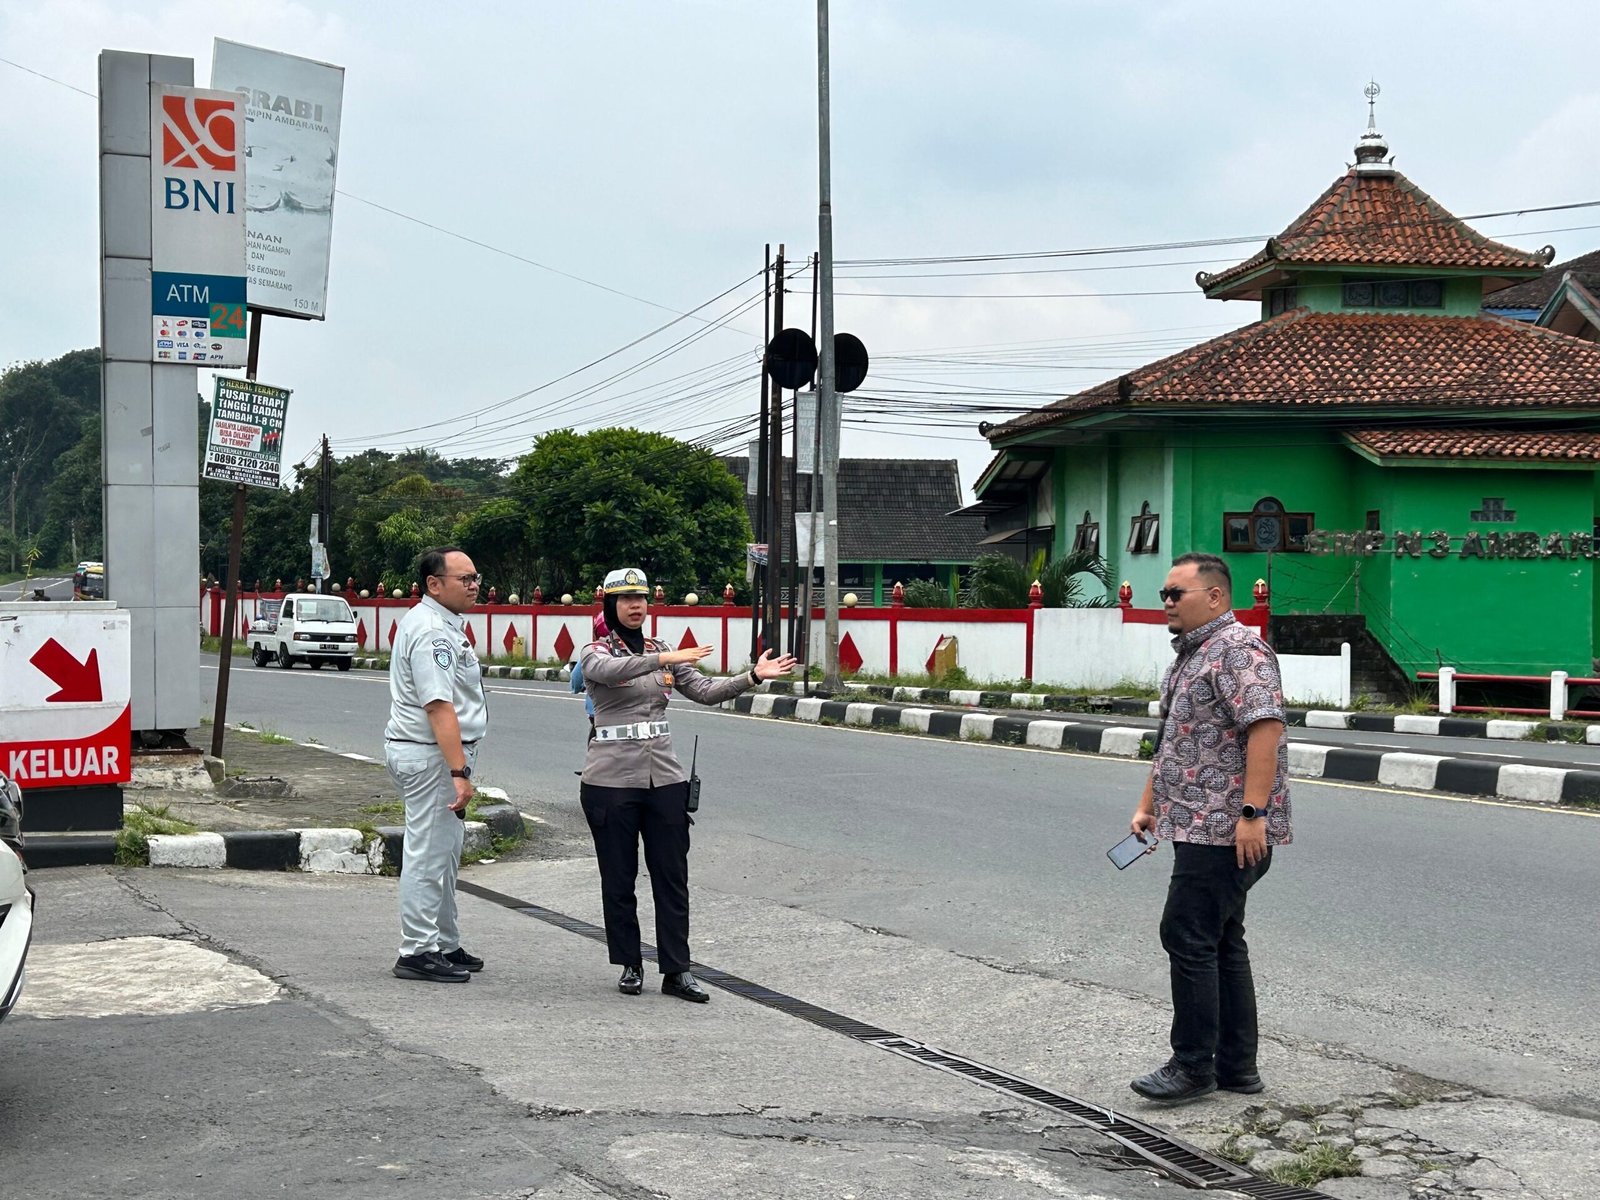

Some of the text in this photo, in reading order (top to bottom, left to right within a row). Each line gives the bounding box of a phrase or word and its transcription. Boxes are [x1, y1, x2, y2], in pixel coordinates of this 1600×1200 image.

[164, 177, 235, 214] BNI
[251, 251, 265, 261] DAN
[257, 265, 286, 277] EKONOMI
[166, 284, 209, 303] ATM
[258, 278, 293, 291] SEMARANG
[293, 298, 319, 312] 150 M
[211, 304, 245, 330] 24
[226, 380, 252, 391] HERBAL
[220, 388, 284, 409] PUSAT TERAPI
[217, 408, 282, 428] TAMBAH 1-8 CM
[218, 398, 283, 419] TINGGI BADAN
[220, 429, 232, 437] BISA
[228, 438, 251, 448] TEMPAT
[214, 453, 237, 465] 0896
[238, 457, 258, 468] 2120
[259, 461, 279, 472] 2340
[1306, 529, 1386, 557] SMP
[1395, 530, 1422, 559] N
[1428, 530, 1450, 559] 3
[1459, 530, 1600, 559] AMBAR
[9, 746, 120, 780] KELUAR
